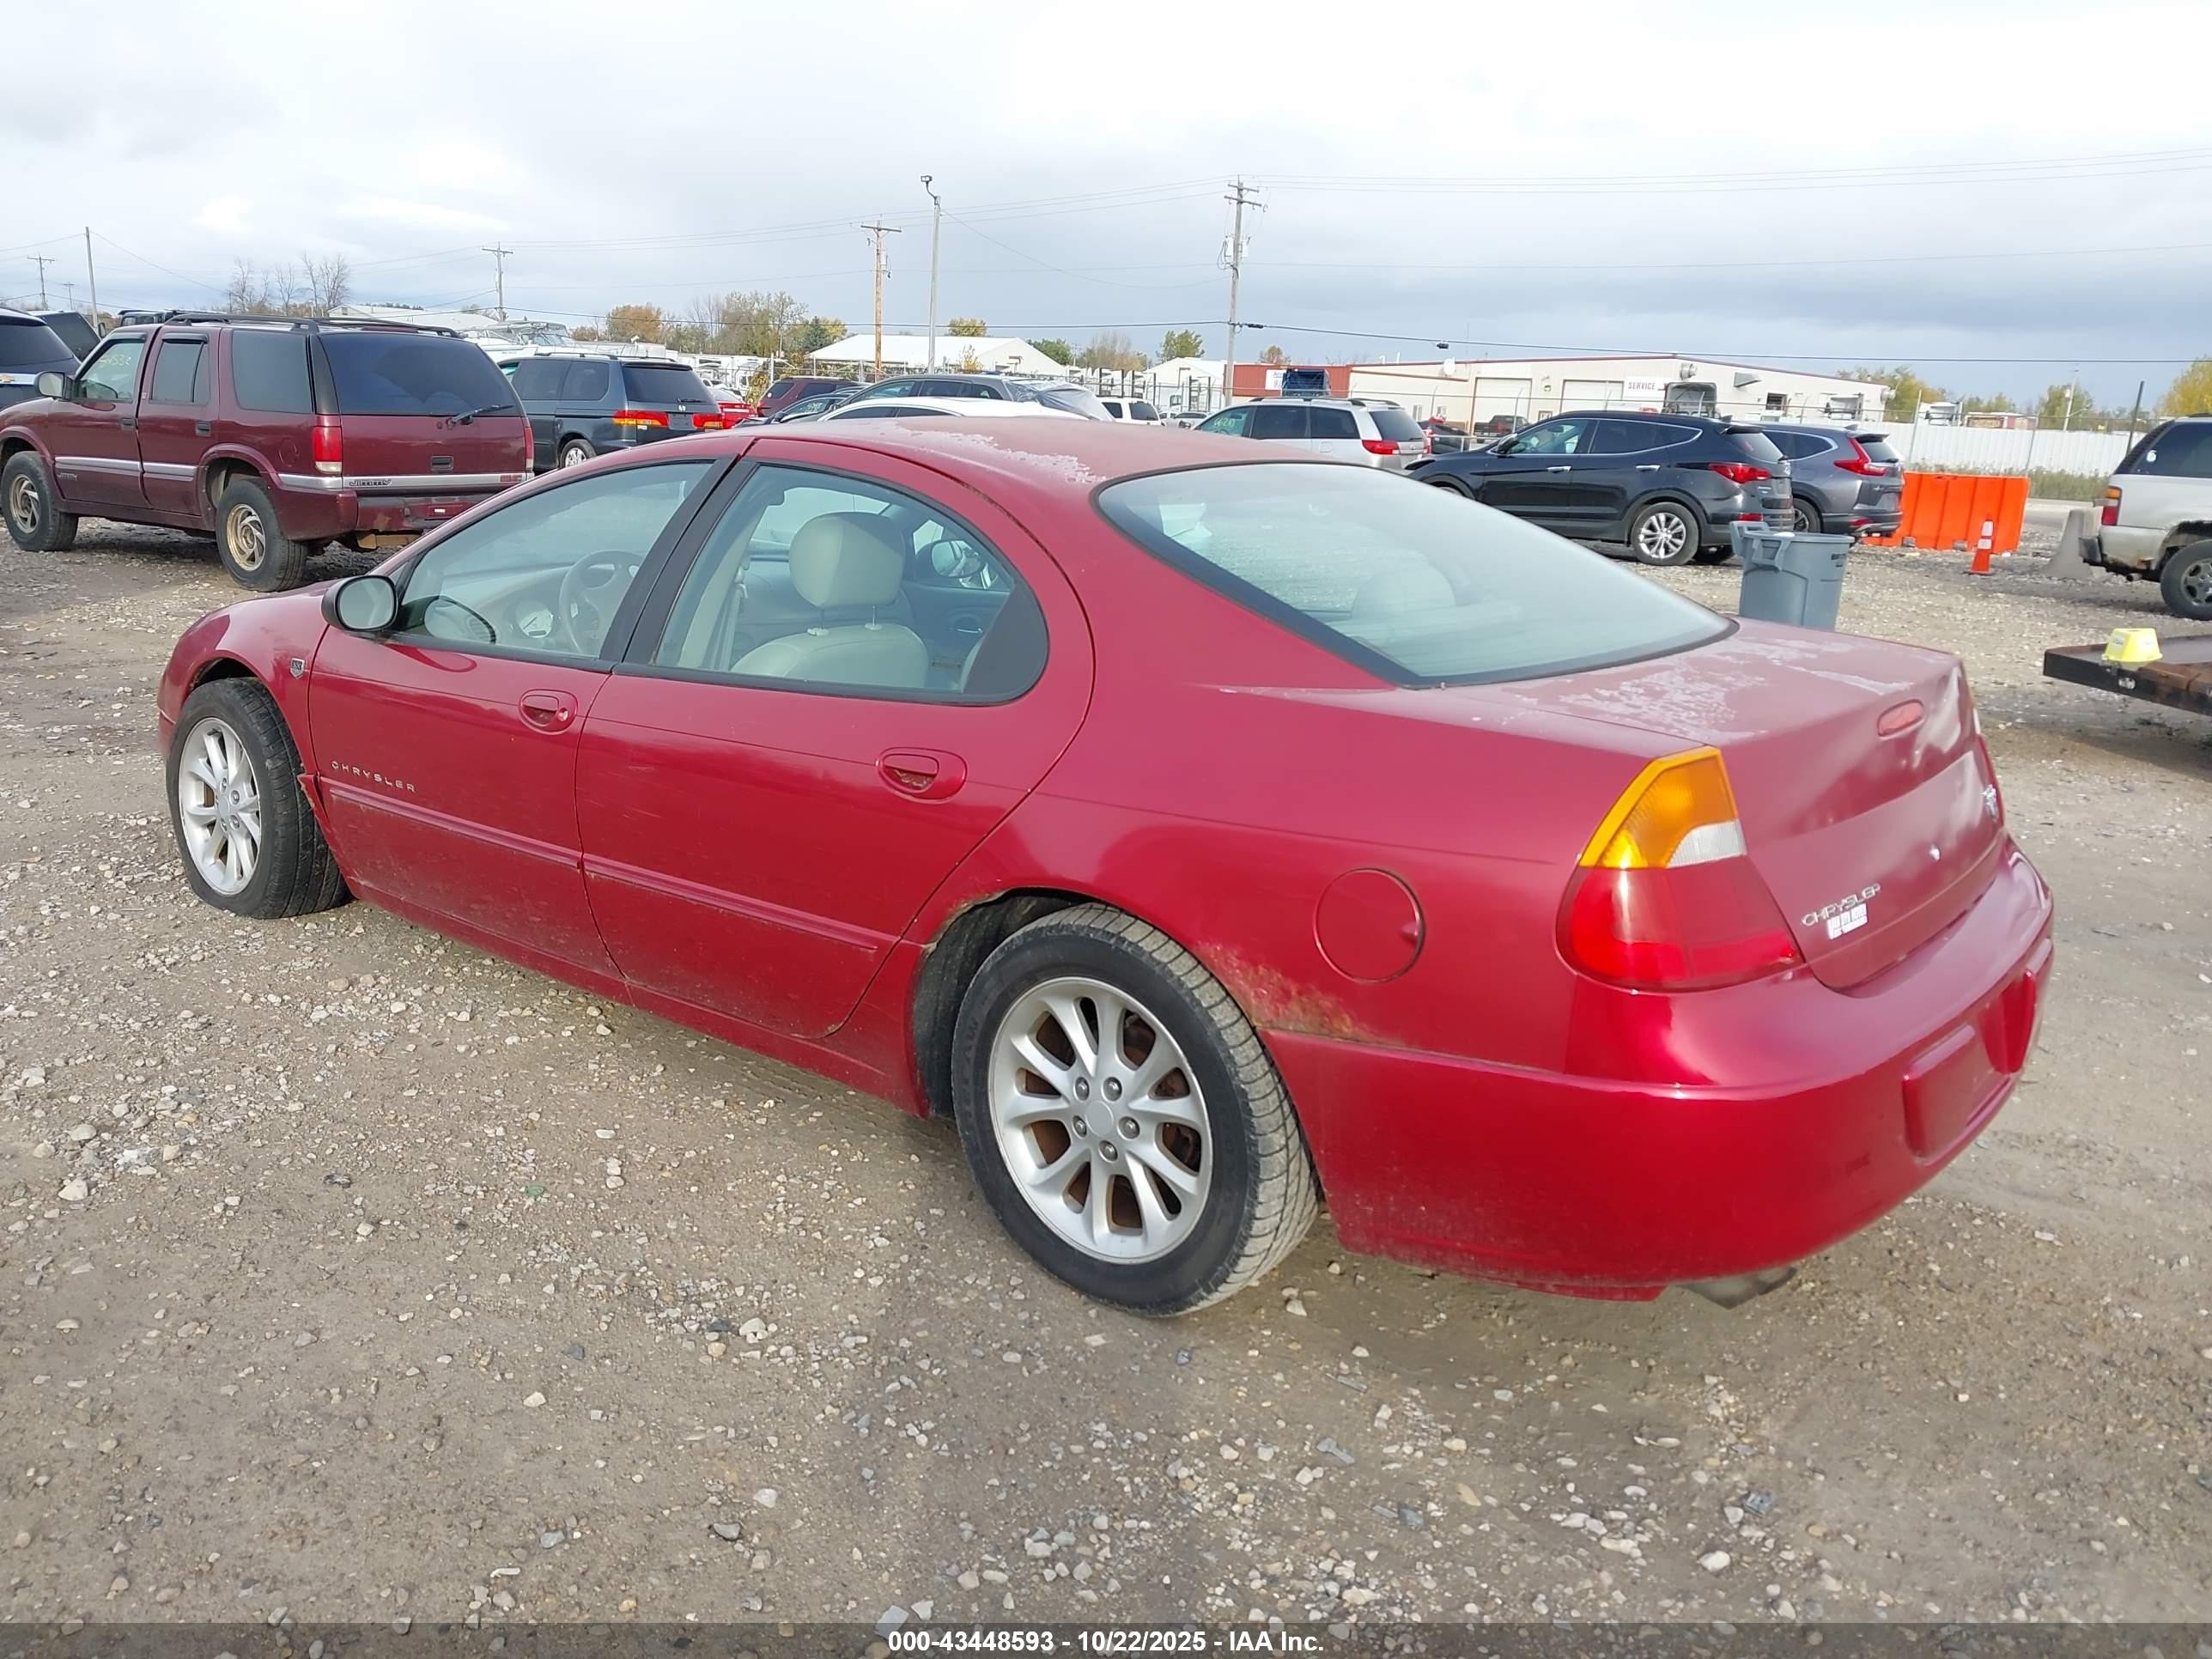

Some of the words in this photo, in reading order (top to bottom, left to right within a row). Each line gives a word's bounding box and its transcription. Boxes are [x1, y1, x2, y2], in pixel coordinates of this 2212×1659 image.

[1627, 381, 1656, 391] SERVICE
[331, 760, 416, 793] CHRYSLER
[1801, 882, 1881, 927] CHRYSLER
